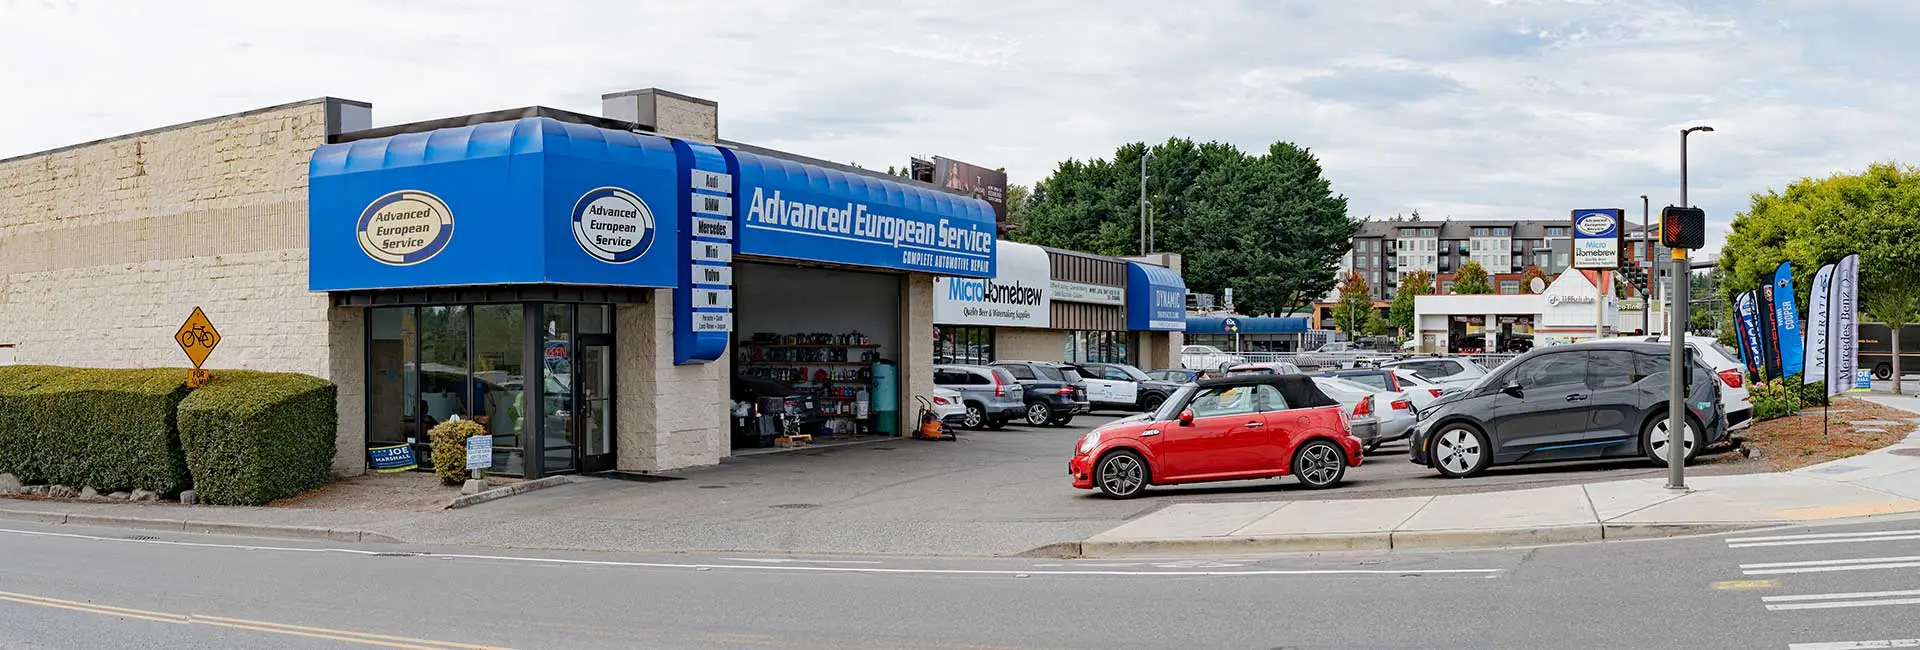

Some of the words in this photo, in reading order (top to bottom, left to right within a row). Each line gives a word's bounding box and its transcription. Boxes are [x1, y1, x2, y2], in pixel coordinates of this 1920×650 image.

[705, 174, 719, 189] Audi
[589, 204, 637, 219] Advanced
[704, 197, 720, 212] BMW
[375, 208, 431, 222] Advanced
[746, 187, 852, 235] Advanced
[854, 203, 935, 248] European
[937, 218, 991, 253] Service
[376, 224, 430, 236] European
[590, 219, 636, 233] European
[698, 220, 727, 236] Mercedes
[382, 237, 424, 249] Service
[595, 234, 632, 247] Service
[1585, 240, 1607, 249] Micro
[705, 245, 719, 259] Mini
[1576, 248, 1616, 257] Homebrew
[902, 250, 933, 265] COMPLETE
[934, 255, 969, 271] AUTOMOTIVE
[970, 259, 989, 273] REPAIR
[704, 267, 720, 282] Volvo
[1156, 290, 1180, 309] DYNAMIC
[1840, 291, 1851, 320] Benz
[963, 307, 978, 317] Quality
[979, 308, 988, 317] Beer
[992, 309, 1015, 320] Winemaking
[1015, 310, 1031, 320] Supplies
[1782, 301, 1795, 330] COOPER
[1816, 295, 1826, 368] MASERATI
[1839, 323, 1852, 380] Mercedes
[192, 370, 205, 378] FOR
[375, 454, 411, 462] MARSHALL
[388, 446, 409, 456] JOE
